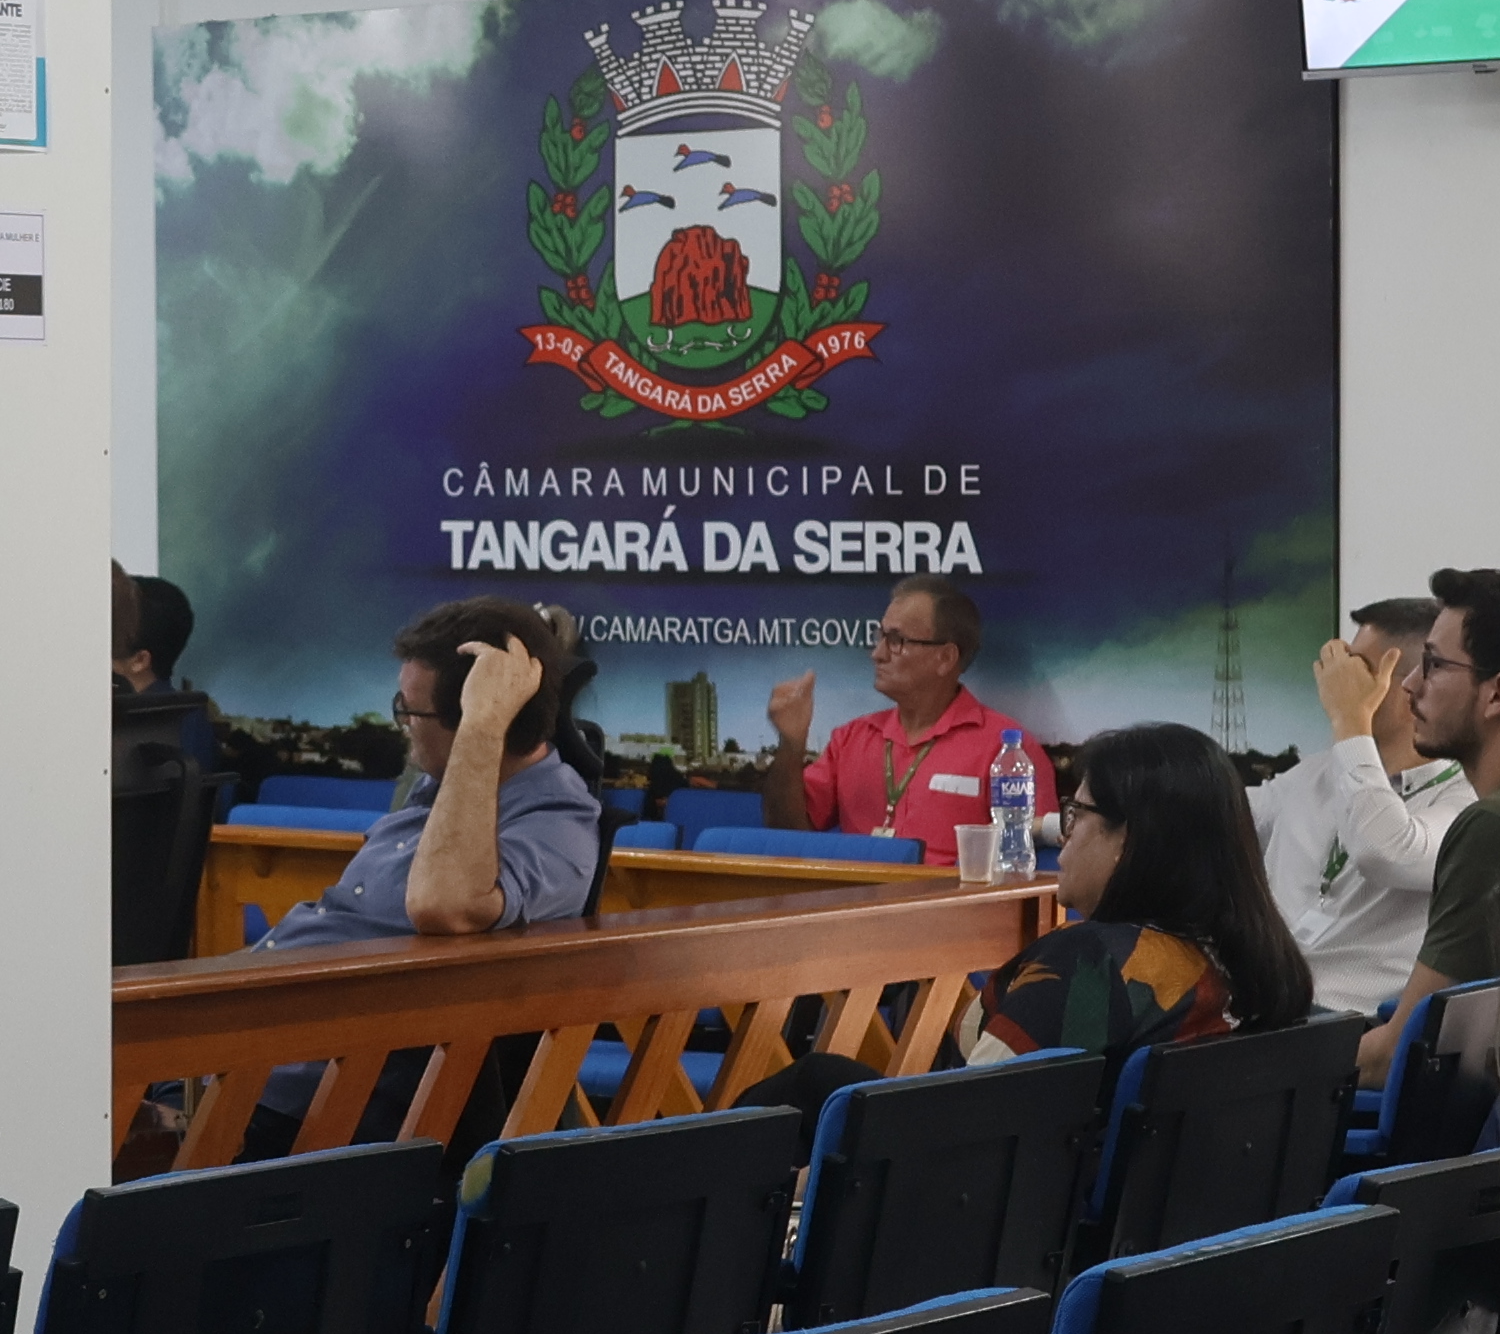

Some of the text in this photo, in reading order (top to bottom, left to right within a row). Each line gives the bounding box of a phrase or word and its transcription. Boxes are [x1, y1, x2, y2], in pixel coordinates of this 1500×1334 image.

[534, 331, 866, 414] 13-05 TANGARÁ DA SERRA 1976
[442, 462, 982, 497] CÂMARA MUNICIPAL DE
[440, 505, 984, 574] TANGARÁ DA SERRA
